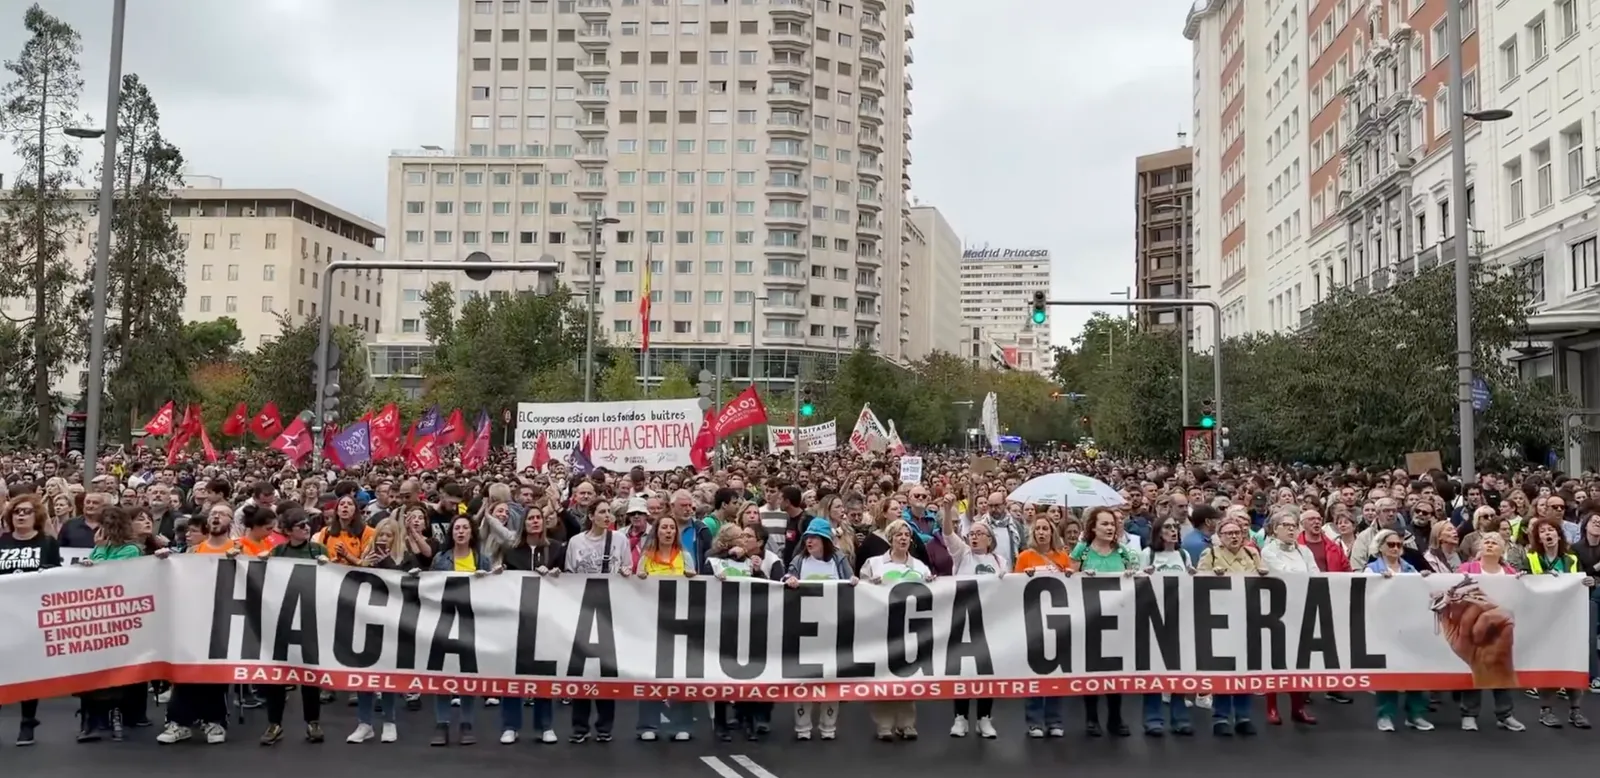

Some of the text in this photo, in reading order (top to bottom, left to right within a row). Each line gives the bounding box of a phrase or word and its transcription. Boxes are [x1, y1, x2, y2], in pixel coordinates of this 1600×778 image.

[963, 247, 1048, 258] Madrid Princesa
[519, 411, 525, 422] El
[527, 411, 565, 425] Congreso
[584, 415, 599, 423] con
[602, 412, 616, 422] los
[617, 410, 645, 421] fondos
[651, 410, 685, 420] buitres
[546, 441, 571, 450] ABAJO
[583, 426, 631, 450] HUELGA
[1, 547, 41, 560] 7291
[41, 584, 124, 607] SINDICATO
[42, 598, 152, 626] DE INQUILINAS
[208, 559, 1386, 680] HACIA LA HUELGA GENERAL
[45, 617, 142, 642] E INQUILINOS
[46, 634, 129, 657] DE MADRID
[234, 667, 333, 686] BAJADA
[348, 674, 396, 689] DEL
[408, 676, 537, 695] ALQUILER
[551, 683, 599, 696] 50%
[633, 682, 826, 698] EXPROPIACIÓN
[840, 683, 941, 697] FONDOS
[954, 681, 1039, 695] BUITRE
[1070, 678, 1213, 692] CONTRATOS
[1226, 675, 1371, 690] INDEFINIDOS
